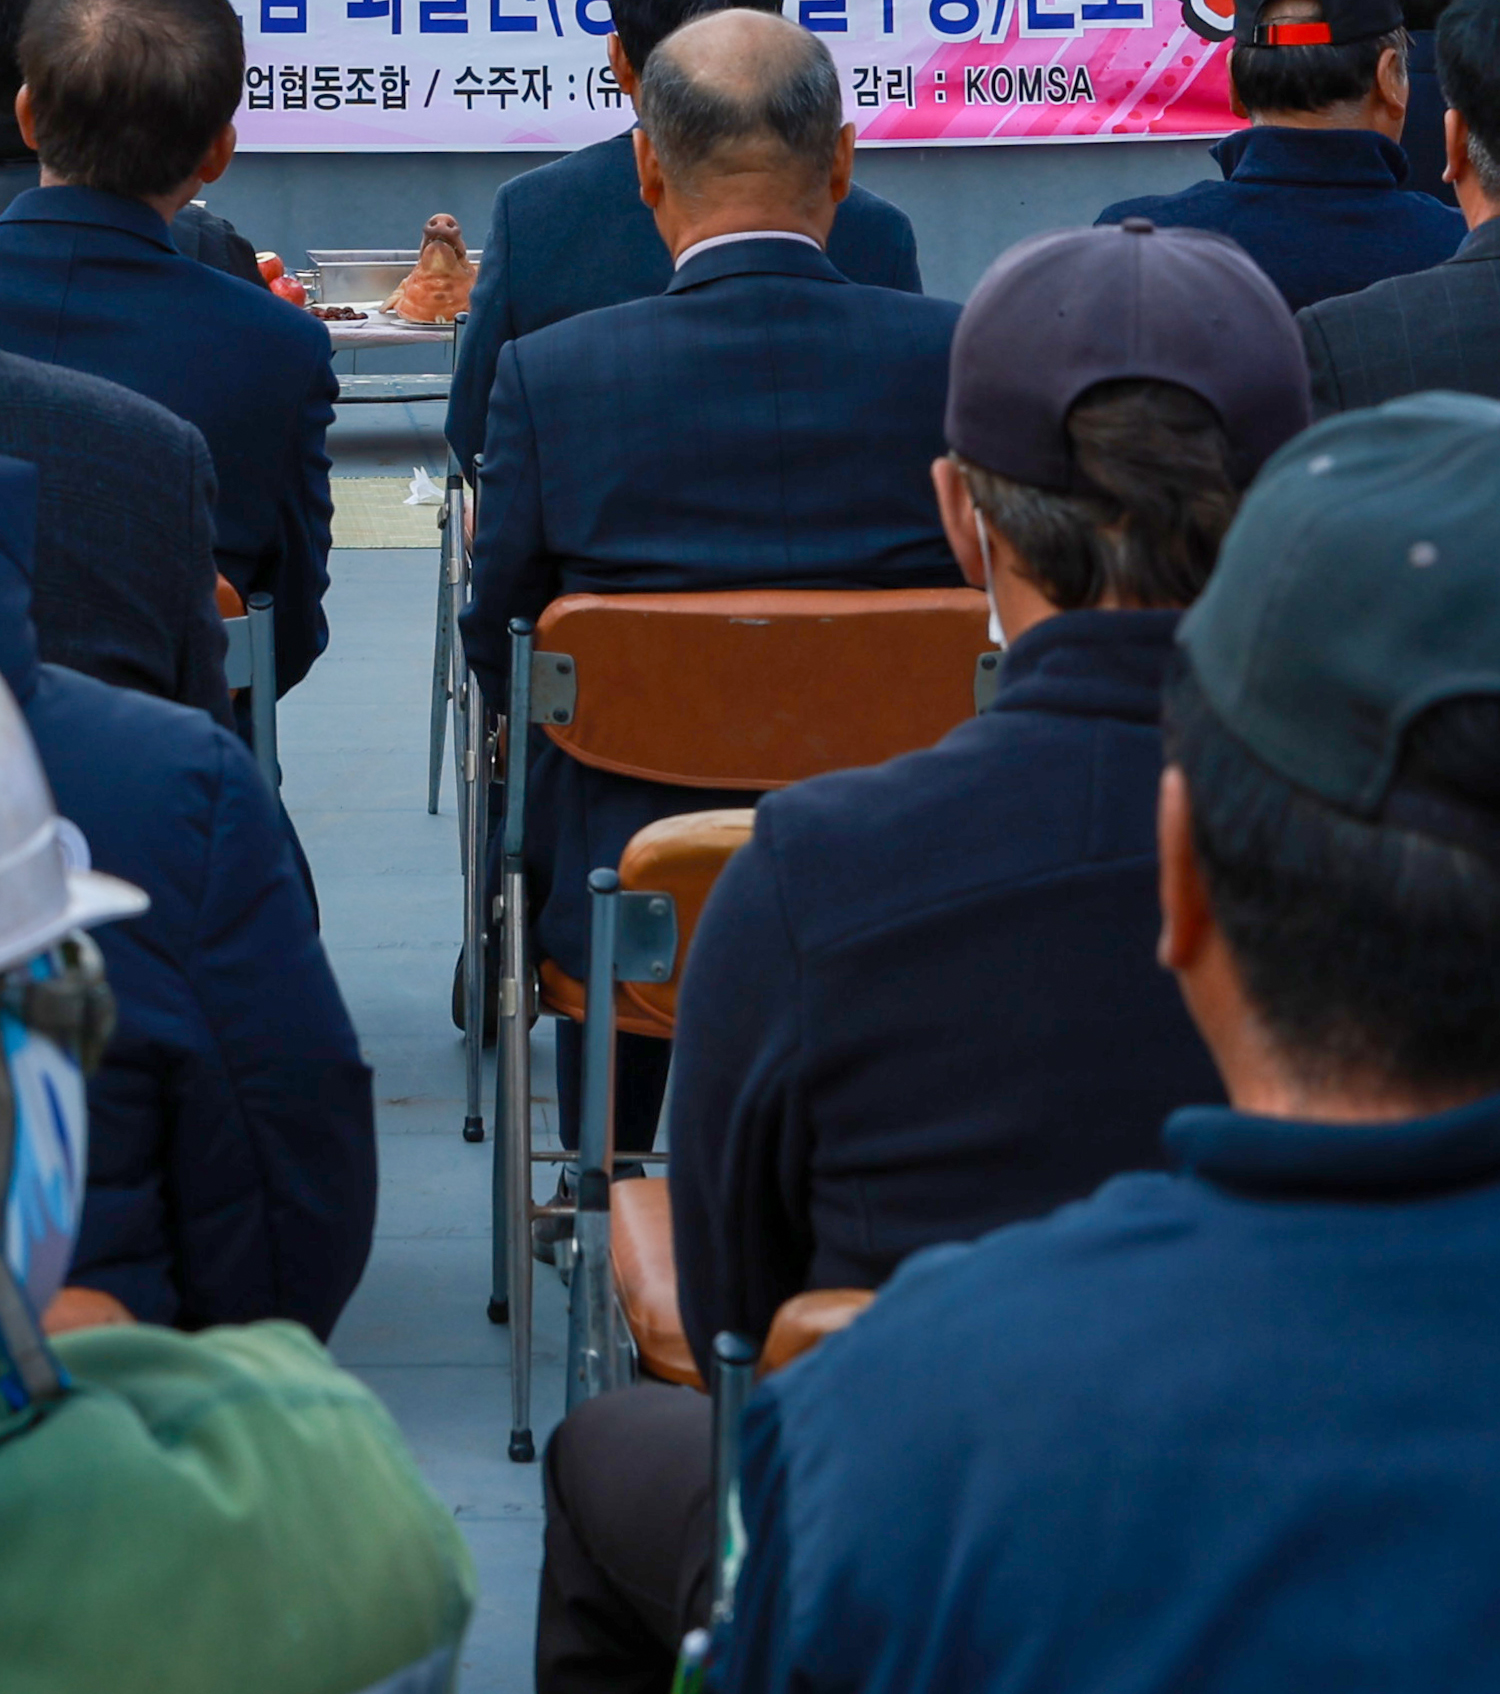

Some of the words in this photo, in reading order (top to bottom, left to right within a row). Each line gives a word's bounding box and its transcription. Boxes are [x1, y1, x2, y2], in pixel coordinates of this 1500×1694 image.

[453, 64, 552, 110] 수주자
[852, 65, 914, 108] 감리
[966, 65, 1095, 104] KOMSA
